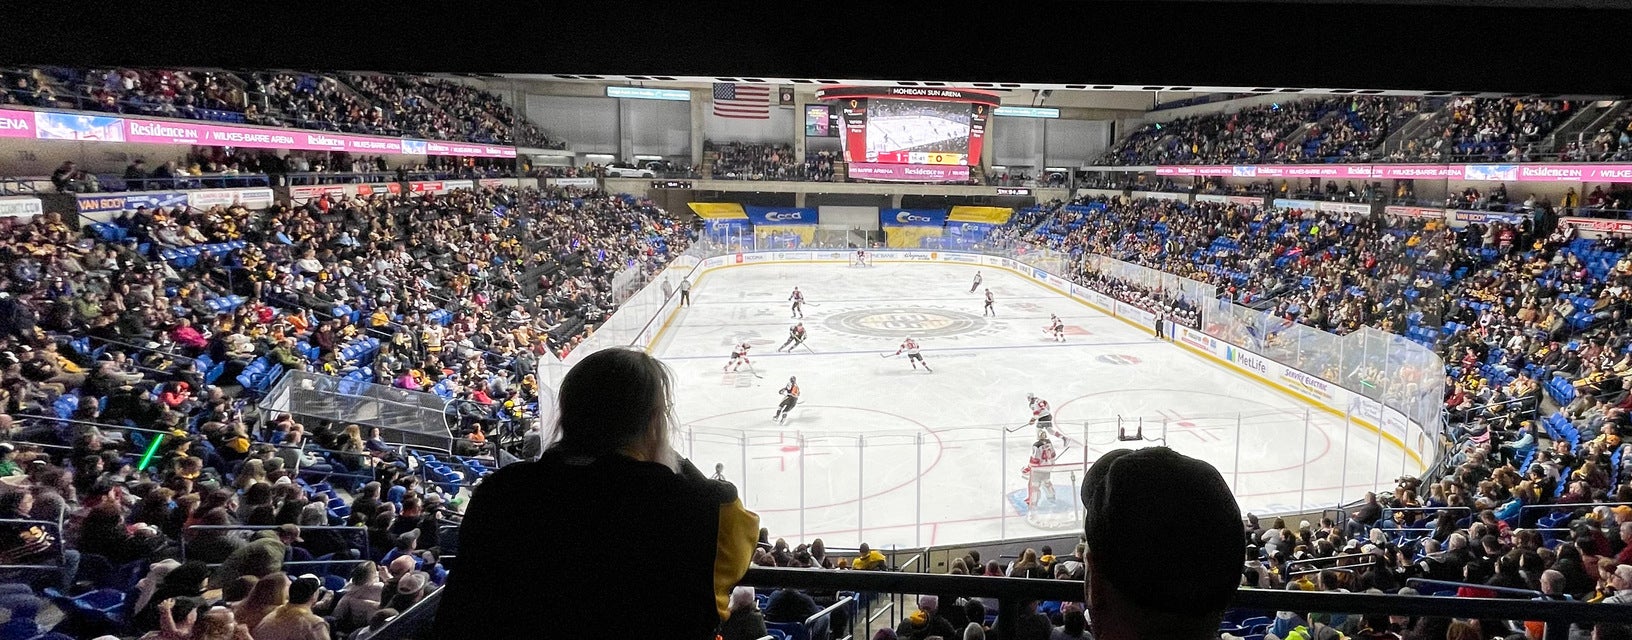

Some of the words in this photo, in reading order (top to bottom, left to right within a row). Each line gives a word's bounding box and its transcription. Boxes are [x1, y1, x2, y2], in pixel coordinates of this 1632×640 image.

[130, 122, 185, 138] Residence
[213, 131, 270, 142] WILKES-BARRE
[271, 135, 294, 144] ARENA
[936, 154, 942, 162] 0
[1523, 167, 1570, 176] Residence
[78, 200, 98, 210] VAN
[1238, 352, 1266, 374] MetLife
[1306, 376, 1328, 391] ELECTRIC
